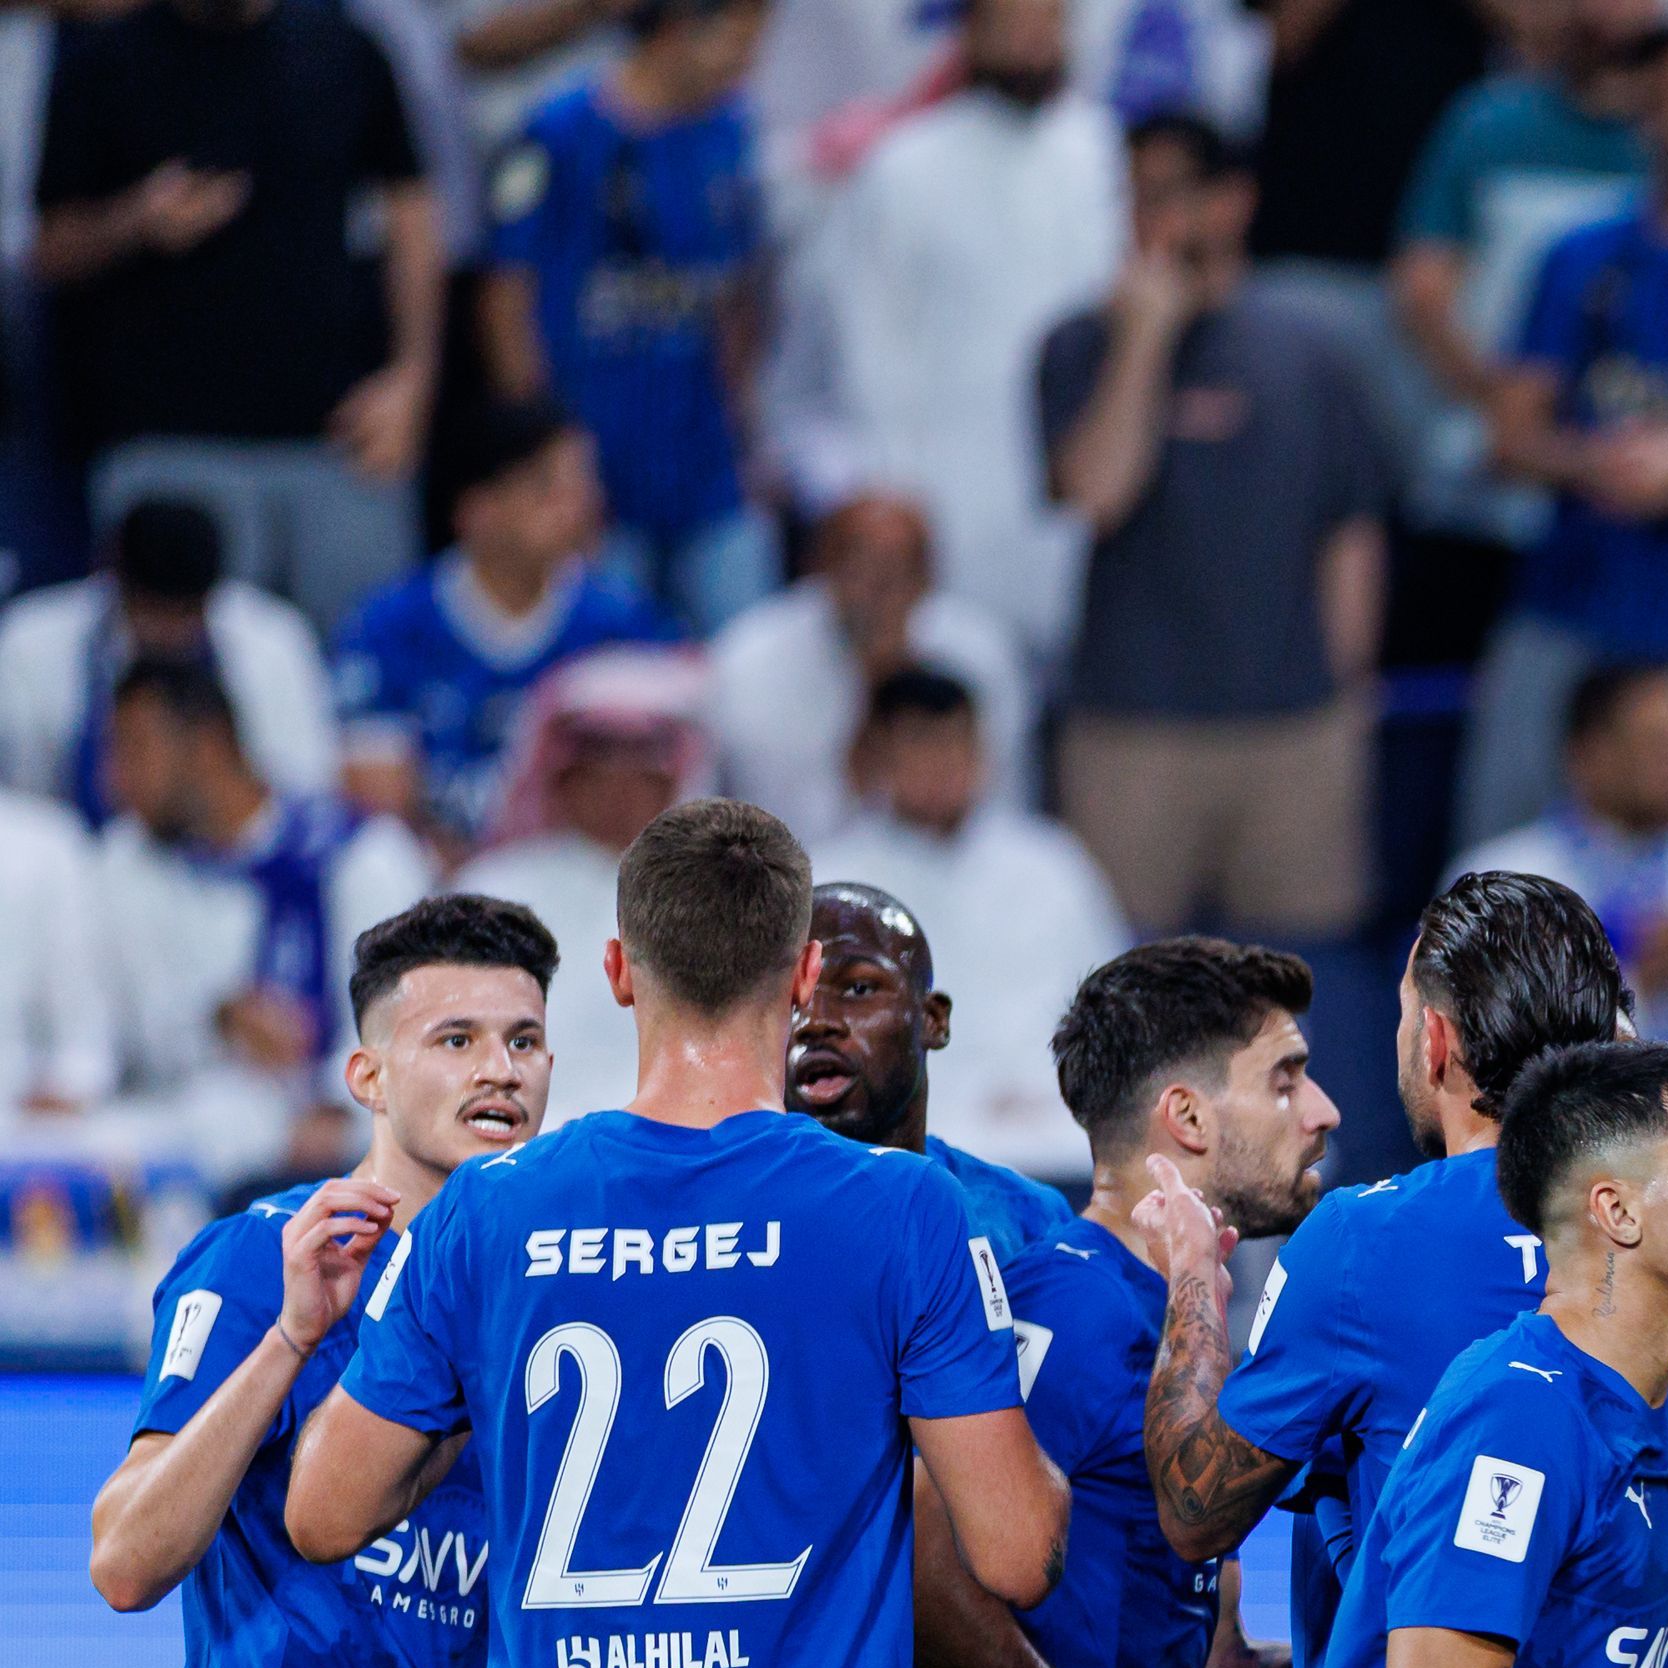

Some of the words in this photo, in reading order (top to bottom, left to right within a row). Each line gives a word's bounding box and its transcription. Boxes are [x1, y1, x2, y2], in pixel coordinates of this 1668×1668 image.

[525, 1221, 780, 1281] SERGEJ
[1503, 1234, 1543, 1284] T
[521, 1316, 813, 1609] 22
